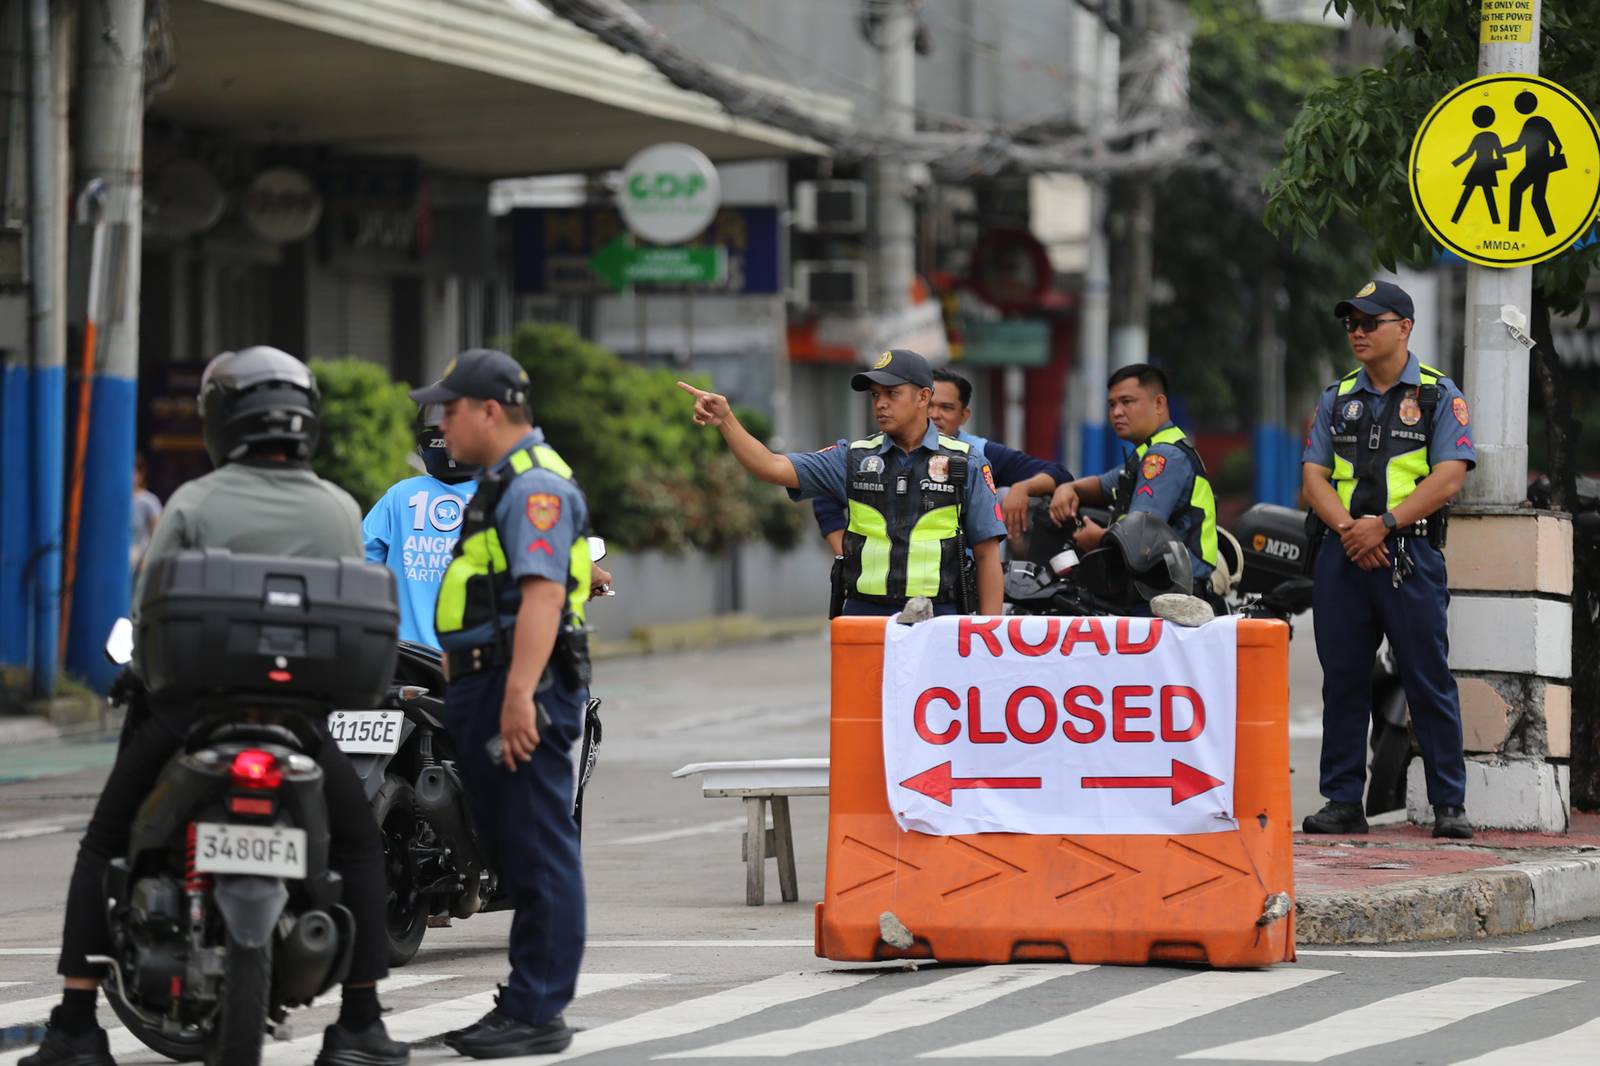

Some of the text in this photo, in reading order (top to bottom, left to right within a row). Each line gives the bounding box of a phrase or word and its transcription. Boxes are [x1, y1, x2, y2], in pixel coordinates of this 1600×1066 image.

[1494, 1, 1514, 9] ONLY
[1515, 1, 1530, 9] ONE
[1491, 13, 1504, 21] THE
[1506, 12, 1533, 21] POWER
[1489, 24, 1522, 32] TO SAVE!
[1482, 240, 1520, 251] MMDA
[1390, 429, 1427, 442] PULIS
[852, 481, 885, 492] GARCIA
[920, 482, 955, 493] PULIS
[1264, 537, 1301, 561] MPD
[957, 616, 1164, 658] ROAD
[913, 685, 1206, 745] CLOSED
[203, 834, 299, 865] 348QFA
